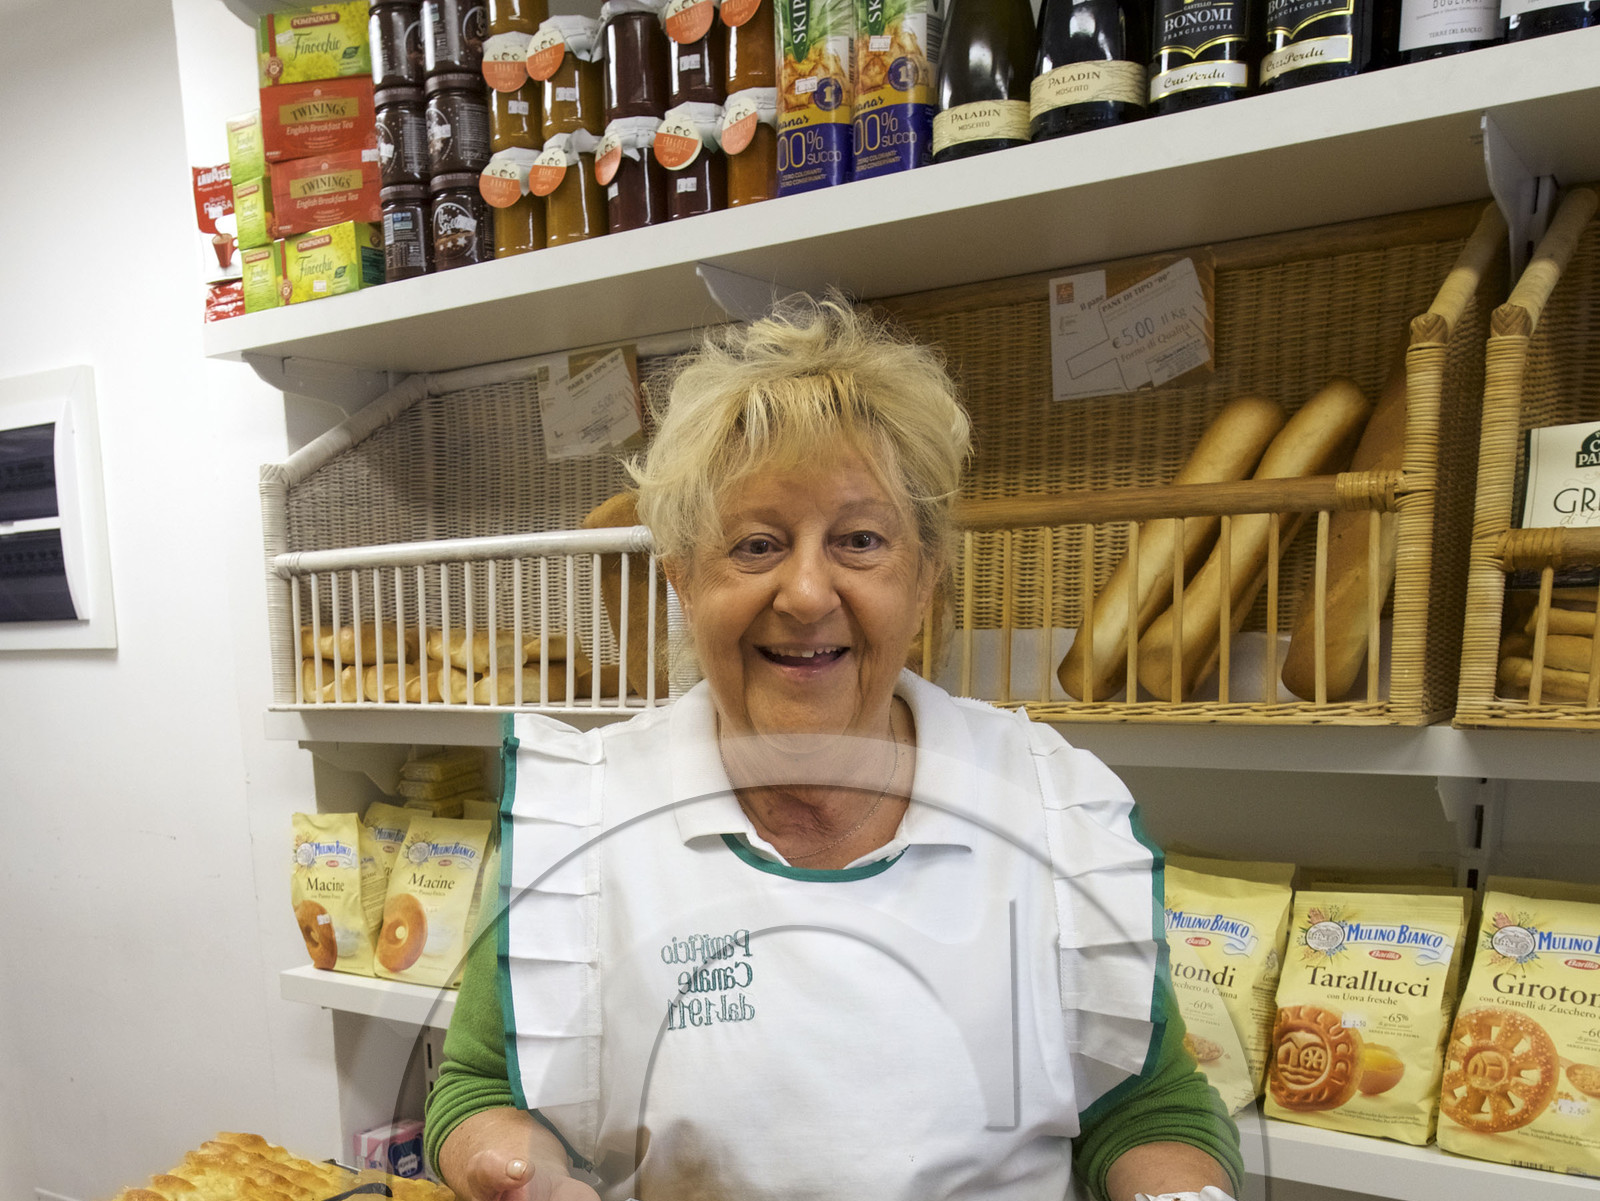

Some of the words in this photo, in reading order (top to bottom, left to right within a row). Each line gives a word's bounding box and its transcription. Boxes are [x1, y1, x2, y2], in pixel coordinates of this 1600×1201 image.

[1183, 1, 1212, 11] CASTELLO
[1164, 8, 1233, 33] BONOMI
[1163, 24, 1233, 42] FRANCIACORTA
[1048, 70, 1101, 89] PALADIN
[1055, 84, 1089, 96] MOSCATO
[290, 102, 346, 121] TWININGS
[951, 109, 1001, 124] PALADIN
[286, 126, 310, 136] English
[310, 122, 341, 134] Breakfast
[342, 120, 354, 131] Tea
[958, 121, 990, 131] MOSCATO
[881, 131, 918, 147] SUCCO
[807, 150, 842, 165] SUCCO
[300, 176, 351, 195] TWININGS
[296, 199, 319, 209] English
[318, 195, 347, 206] Breakfast
[347, 192, 359, 201] Tea
[1102, 298, 1121, 312] PANE
[1123, 292, 1133, 301] DI
[1553, 487, 1600, 514] GR
[314, 843, 336, 856] MULINO
[430, 844, 451, 857] MULINO
[450, 841, 476, 859] BIANCO
[306, 876, 345, 892] Macine
[408, 872, 456, 890] Macine
[1170, 911, 1211, 930] MULINO
[1210, 914, 1250, 938] BIANCO
[1346, 923, 1396, 942] MULINO
[1396, 924, 1443, 948] BIANCO
[1538, 931, 1593, 951] MULINO
[1566, 960, 1600, 970] Barilla
[1305, 964, 1431, 997] Tarallucci
[1211, 987, 1239, 1000] Canna
[1342, 992, 1365, 1002] Uova
[1367, 994, 1398, 1006] fresche
[1479, 995, 1495, 1003] con
[1496, 996, 1536, 1010] Granelli
[1537, 1003, 1547, 1011] di
[1548, 1004, 1597, 1019] Zucchero
[1383, 1012, 1409, 1023] -65%
